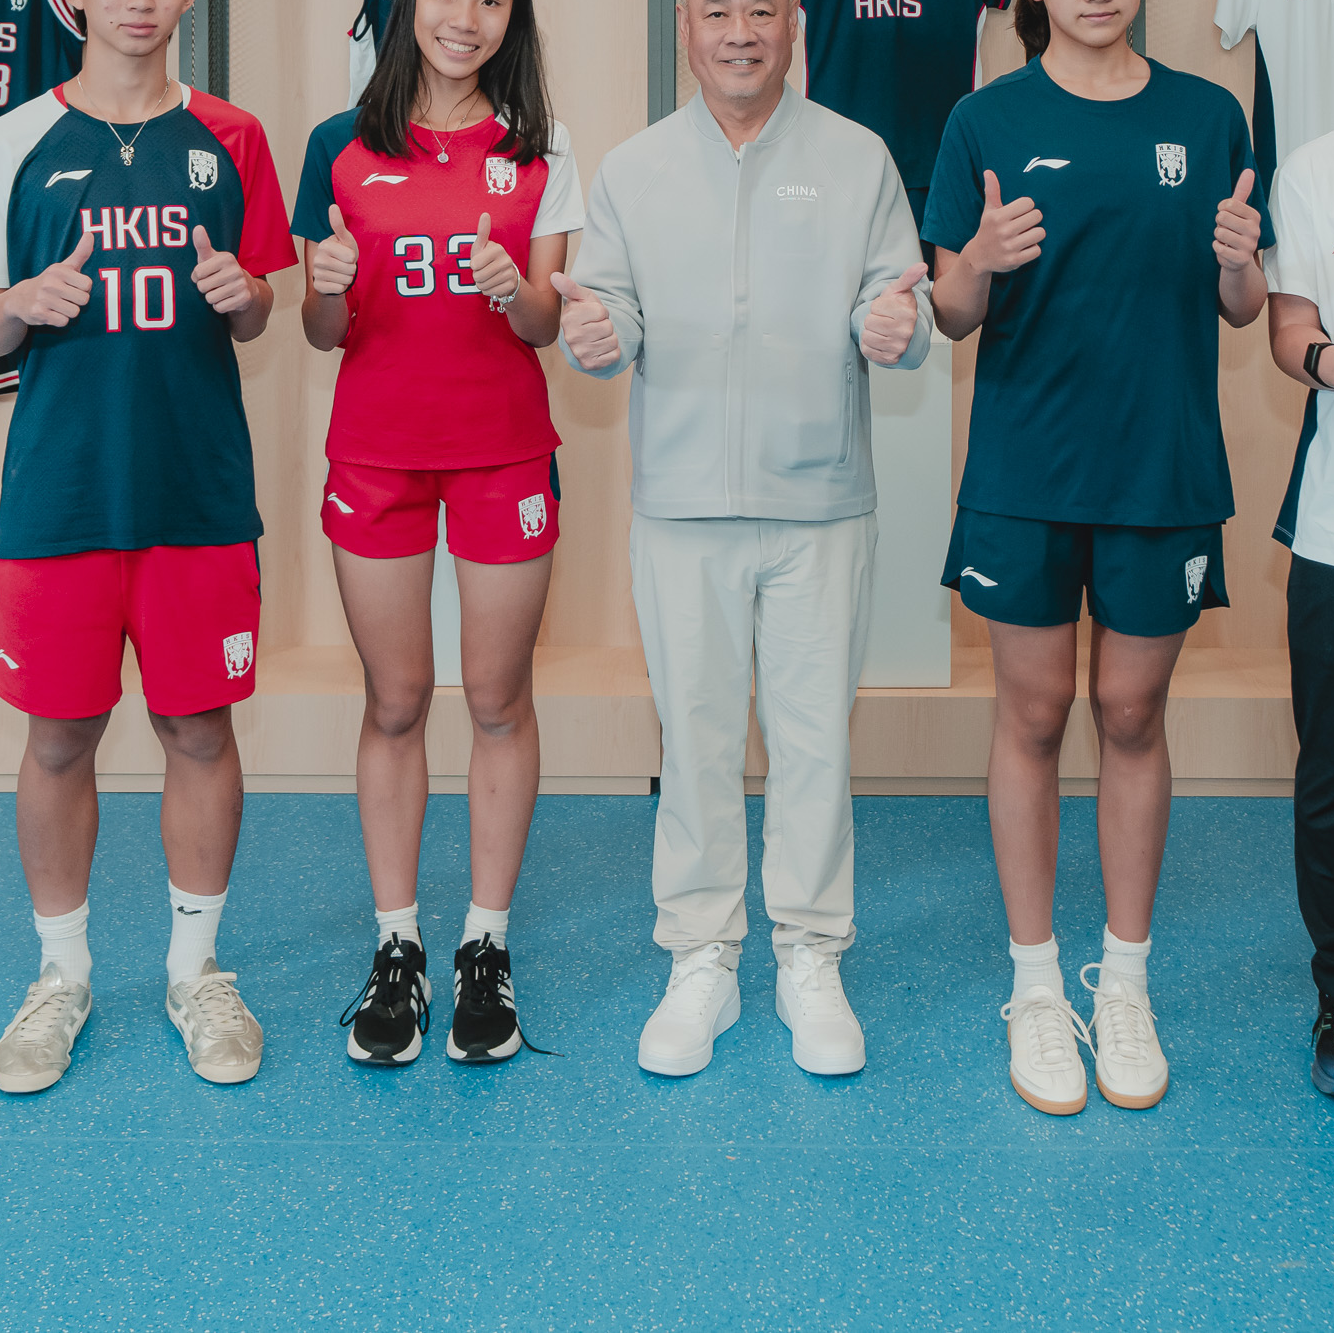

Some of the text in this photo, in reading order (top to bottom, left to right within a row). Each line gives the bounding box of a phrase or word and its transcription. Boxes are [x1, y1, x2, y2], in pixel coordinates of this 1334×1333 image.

[1159, 145, 1183, 153] HKIS
[776, 185, 818, 198] CHINA
[80, 204, 189, 251] HKIS
[98, 265, 176, 332] 10
